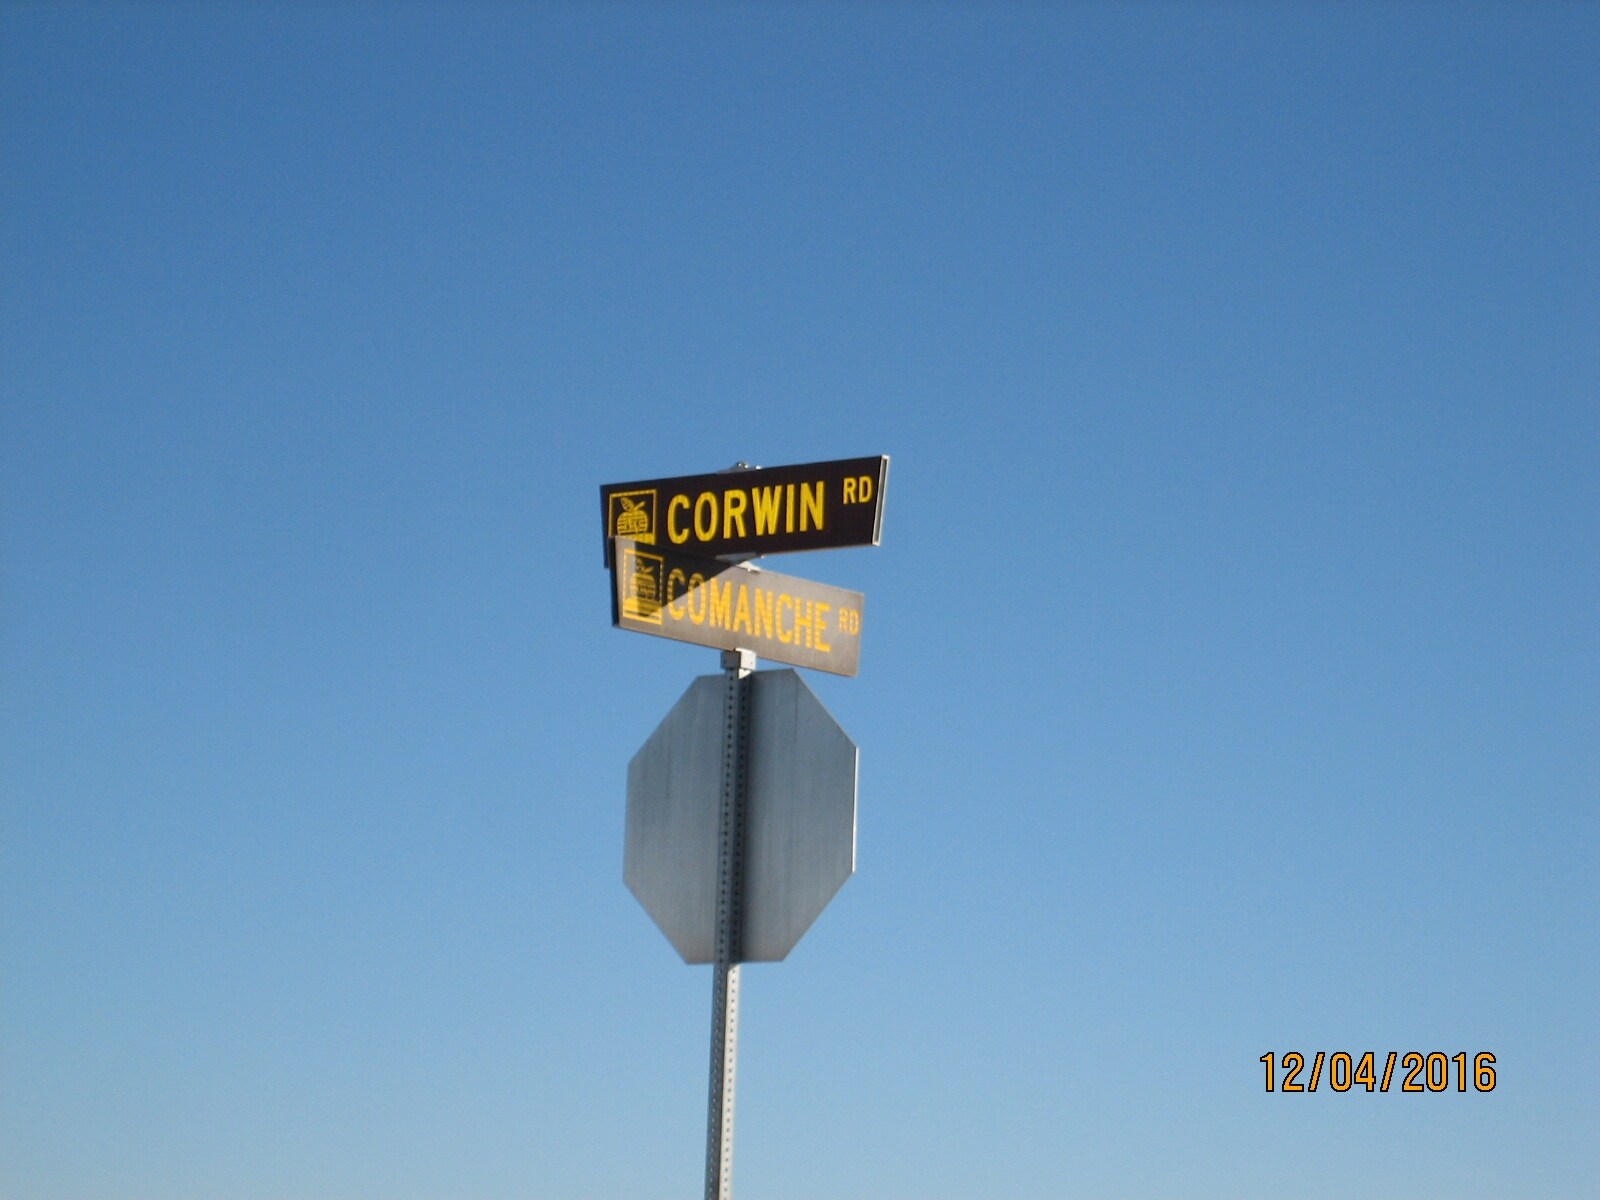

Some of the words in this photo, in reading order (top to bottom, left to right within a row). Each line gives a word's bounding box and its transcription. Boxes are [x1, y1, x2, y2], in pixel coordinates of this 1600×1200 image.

[667, 481, 825, 545] CORWIN
[842, 475, 874, 505] RD
[666, 567, 832, 653] COMANCHE
[838, 607, 861, 636] RD
